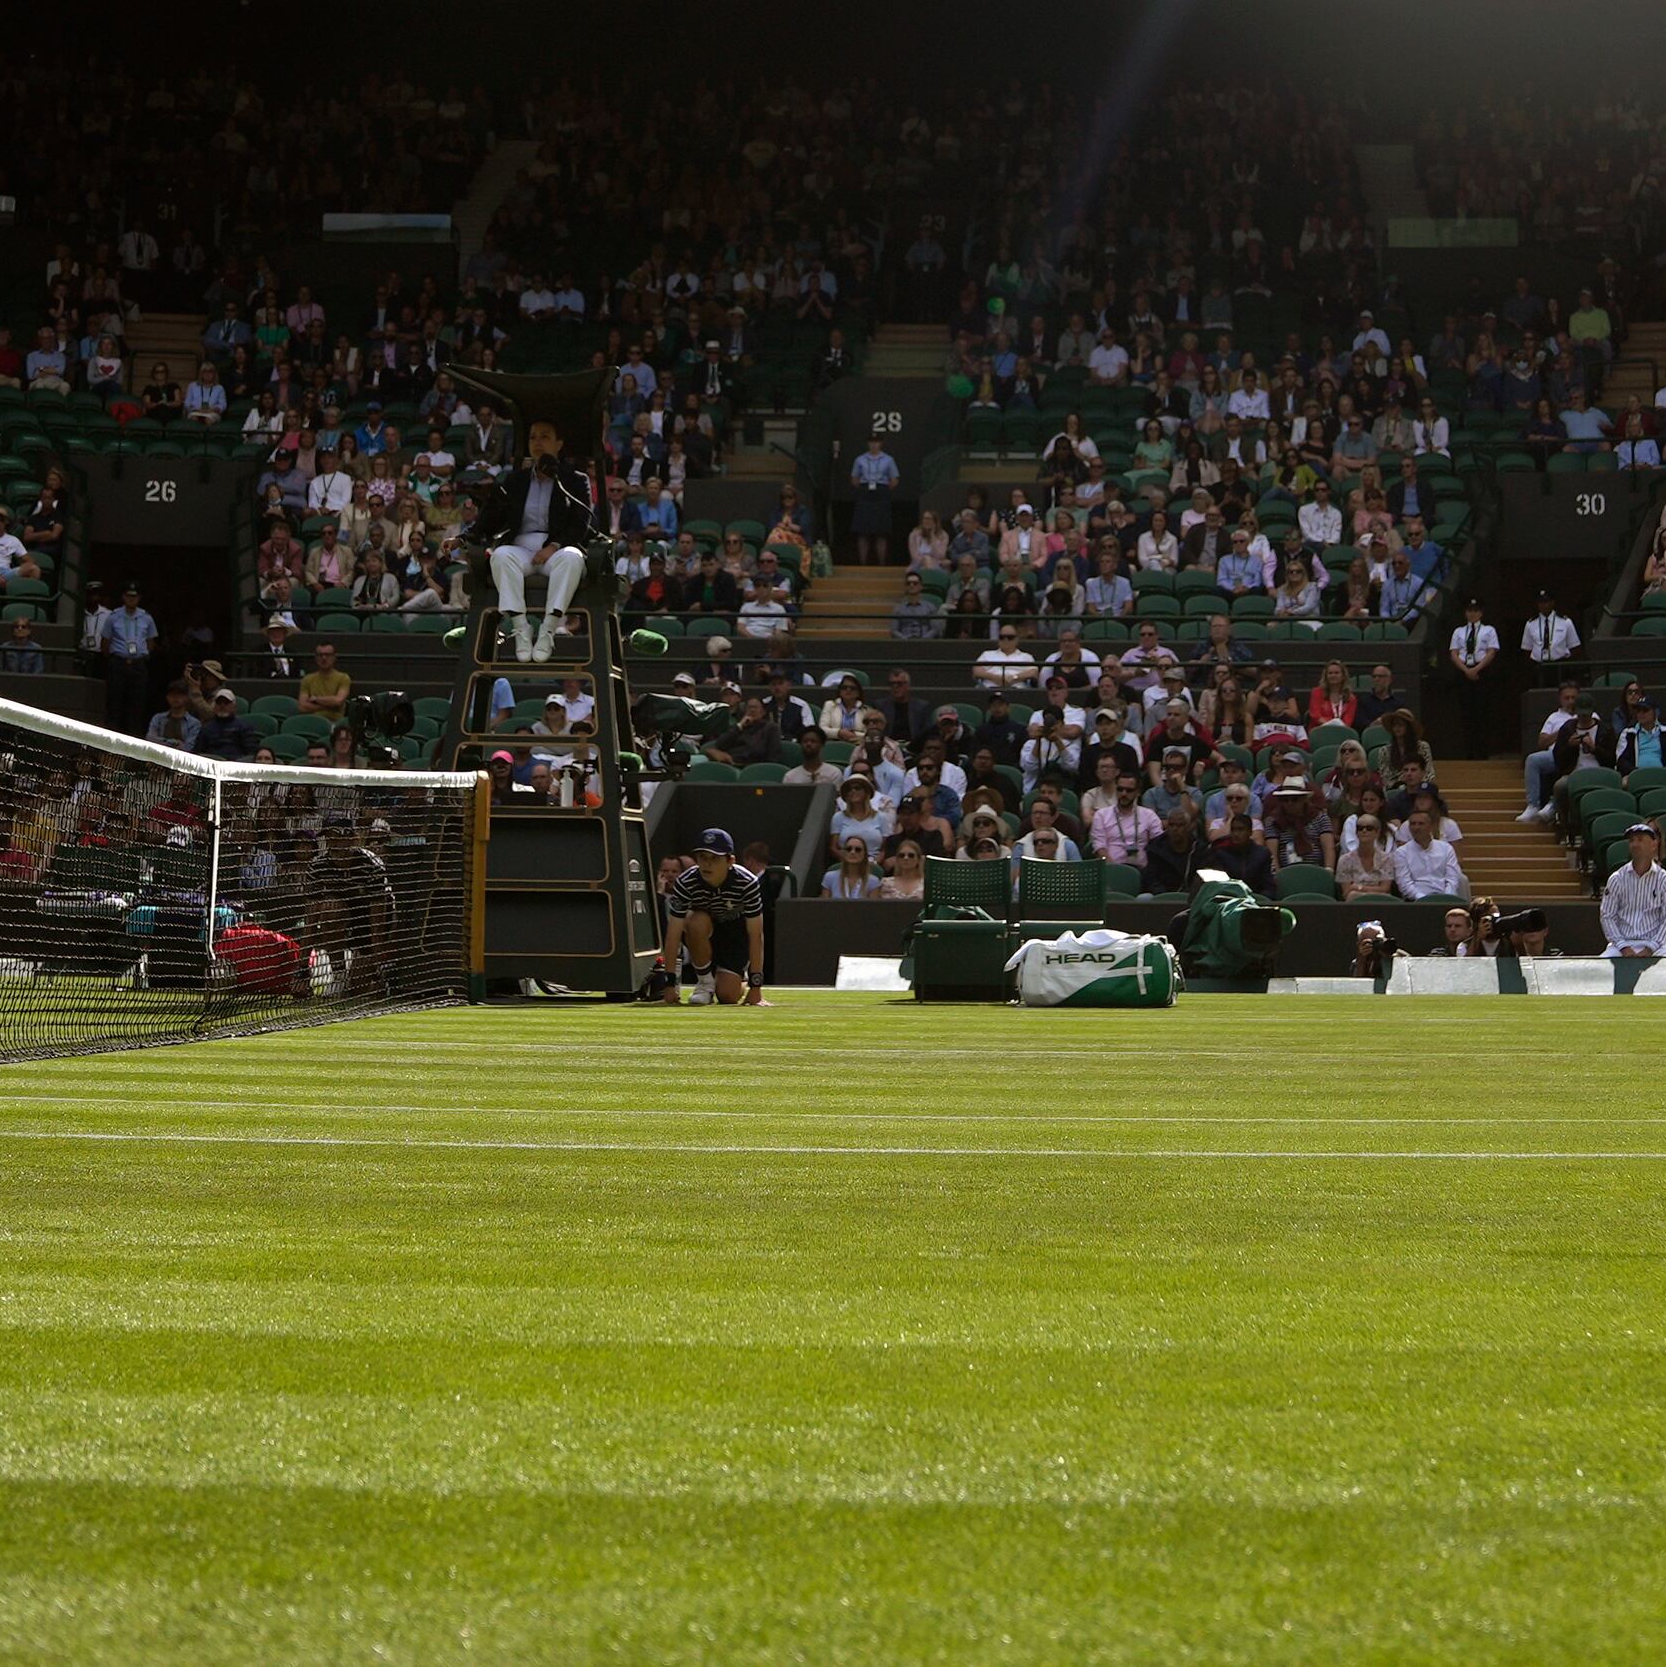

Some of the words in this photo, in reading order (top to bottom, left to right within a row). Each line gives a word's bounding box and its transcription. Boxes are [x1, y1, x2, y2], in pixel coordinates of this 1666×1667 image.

[157, 203, 177, 221] 31
[872, 411, 903, 433] 28
[145, 480, 176, 502] 26
[1576, 493, 1605, 515] 30
[1046, 953, 1115, 965] HEAD
